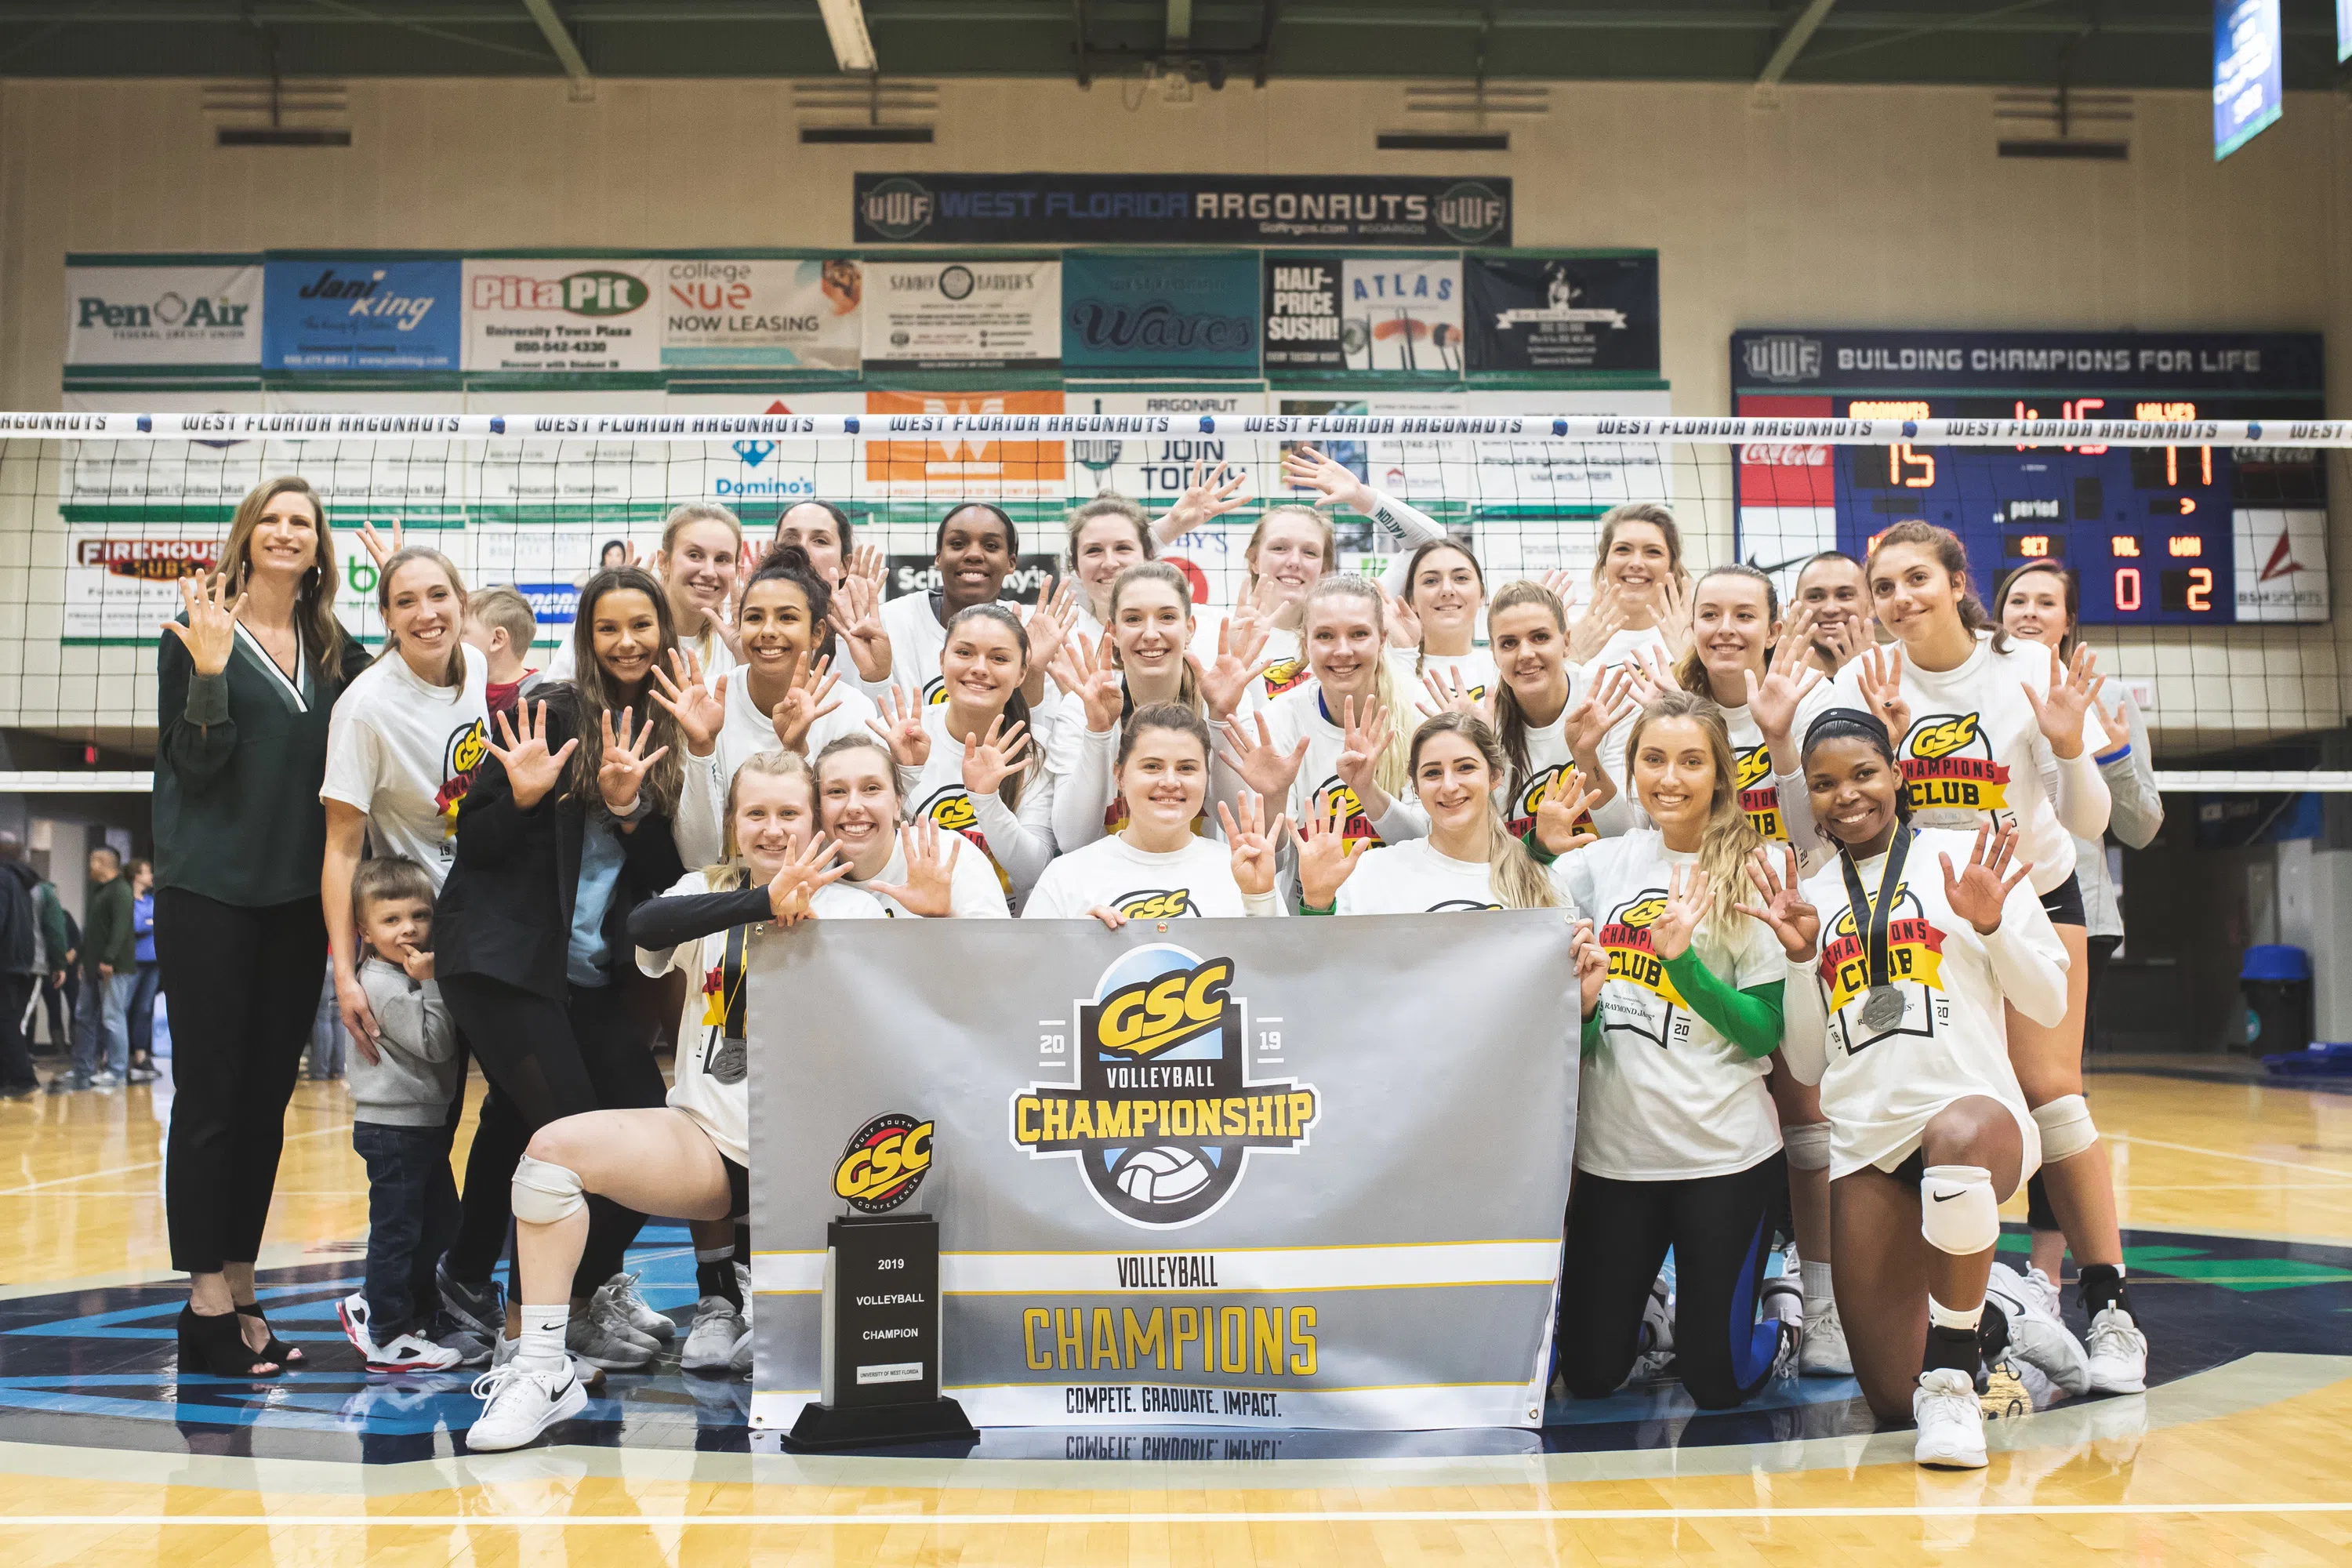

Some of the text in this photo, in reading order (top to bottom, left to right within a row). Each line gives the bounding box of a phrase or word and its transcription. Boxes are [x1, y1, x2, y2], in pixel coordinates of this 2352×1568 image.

[941, 192, 1428, 220] WEST FLORIDA ARGONAUTS
[299, 269, 387, 299] Jani
[669, 264, 751, 283] college
[1273, 267, 1333, 290] HALF-
[1353, 274, 1452, 301] ATLAS
[78, 296, 249, 328] Pen Air
[1273, 292, 1334, 314] PRICE
[485, 325, 632, 337] University Town Plaza
[668, 315, 820, 332] NOW LEASING
[1073, 303, 1250, 347] Waves
[1268, 316, 1340, 340] SUSHI!
[1837, 348, 2261, 372] BUILDING CHAMPIONS FOR LIFE
[1146, 398, 1239, 412] ARGONAUT
[181, 416, 460, 433] WEST FLORIDA ARGONAUTS
[534, 418, 813, 433] WEST FLORIDA ARGONAUTS
[889, 416, 1169, 432] WEST FLORIDA ARGONAUTS
[1243, 416, 1523, 434] WEST FLORIDA ARGONAUTS
[1596, 419, 1872, 437] WEST FLORIDA ARGONAUTS
[1945, 422, 2218, 439] WEST FLORIDA ARGONAUTS
[2289, 424, 2343, 439] WEST
[1161, 441, 1224, 460] JOIN
[716, 477, 814, 495] Domino's
[2010, 499, 2060, 521] period
[82, 540, 225, 567] FIREHOUS
[2112, 536, 2140, 557] TOL
[133, 560, 195, 579] SUBS
[2115, 568, 2141, 611] 0
[2187, 568, 2213, 611] 2
[1911, 713, 1977, 756] GSC
[1736, 746, 1769, 782] SC
[1902, 759, 1995, 780] HAMPIONS
[1908, 782, 1980, 807] CLUB
[932, 796, 975, 823] GS
[1607, 951, 1662, 988] CLUB
[1098, 964, 1227, 1048] GSC
[1604, 1001, 1637, 1015] RAYMOND
[1674, 1022, 1690, 1036] 20
[1040, 1031, 1282, 1054] 20 19
[1106, 1066, 1215, 1088] VOLLEYBALL
[1018, 1092, 1313, 1142] CHAMPIONSHIP
[854, 1120, 913, 1149] GULF SOUTH
[836, 1122, 932, 1197] GSC
[858, 1177, 919, 1210] CONFERENCE
[877, 1258, 905, 1270] 2019
[1116, 1255, 1218, 1288] VOLLEYBALL
[856, 1293, 925, 1306] VOLLEYBALL
[862, 1327, 919, 1341] CHAMPION
[1022, 1305, 1318, 1376] CHAMPIONS
[1065, 1386, 1283, 1417] COMPETE. GRADUATE. IMPACT.
